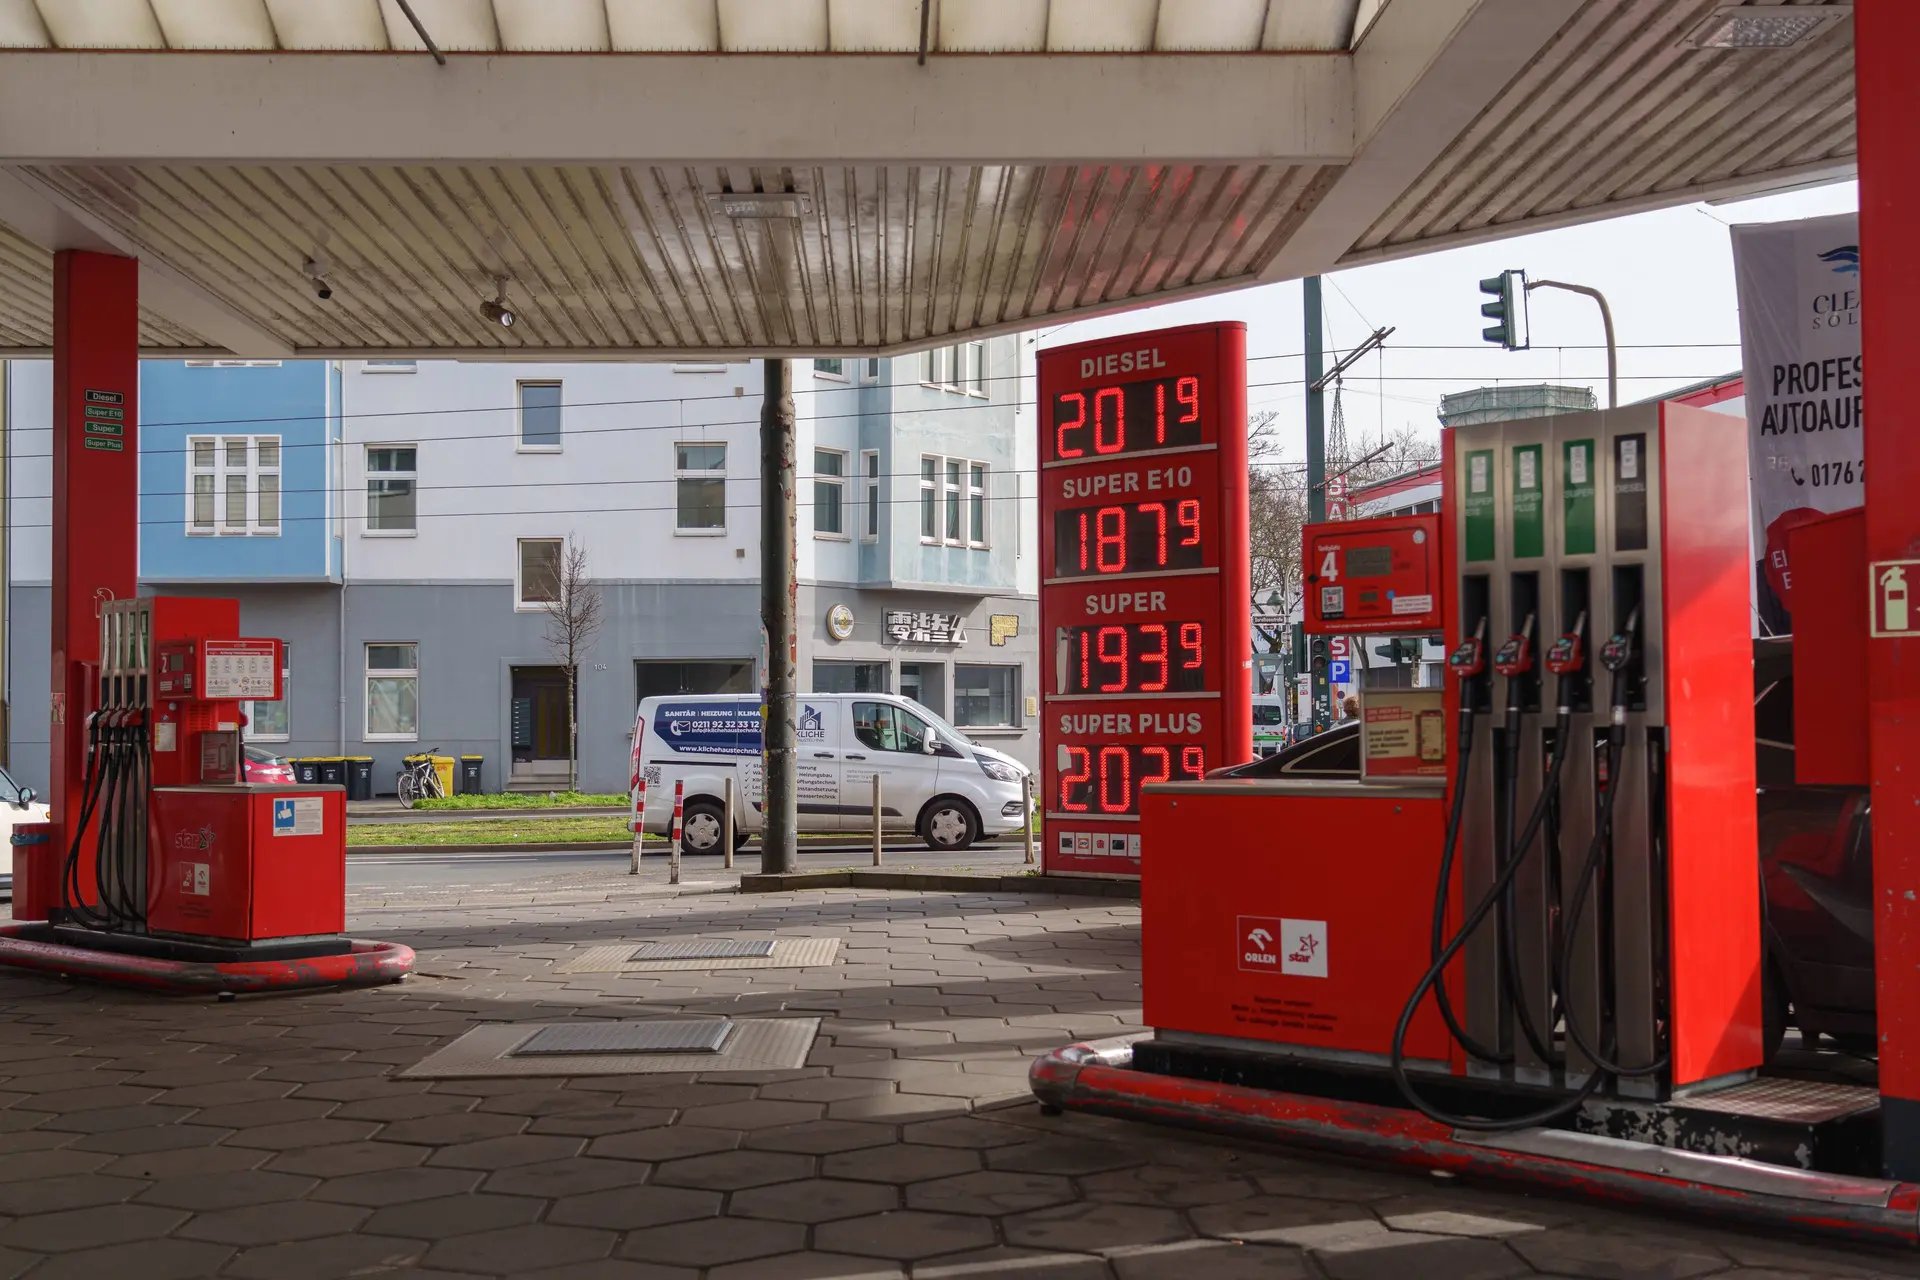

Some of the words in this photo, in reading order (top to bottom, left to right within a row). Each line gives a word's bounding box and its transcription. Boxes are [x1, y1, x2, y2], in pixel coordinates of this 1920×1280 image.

[1813, 291, 1860, 314] CLE
[1081, 348, 1166, 378] DIESEL
[93, 393, 117, 401] Diesel
[93, 424, 115, 432] Super
[1063, 472, 1140, 499] SUPER
[1147, 466, 1192, 490] E10
[1811, 461, 1854, 487] 0176
[1321, 551, 1339, 582] 4
[1086, 591, 1167, 615] SUPER
[161, 656, 167, 673] 2
[1332, 663, 1346, 681] P
[665, 709, 696, 717] SANITÄR
[1060, 713, 1132, 734] SUPER
[1139, 712, 1203, 734] PLUS
[1245, 952, 1276, 964] ORLEN
[1288, 952, 1311, 963] star
